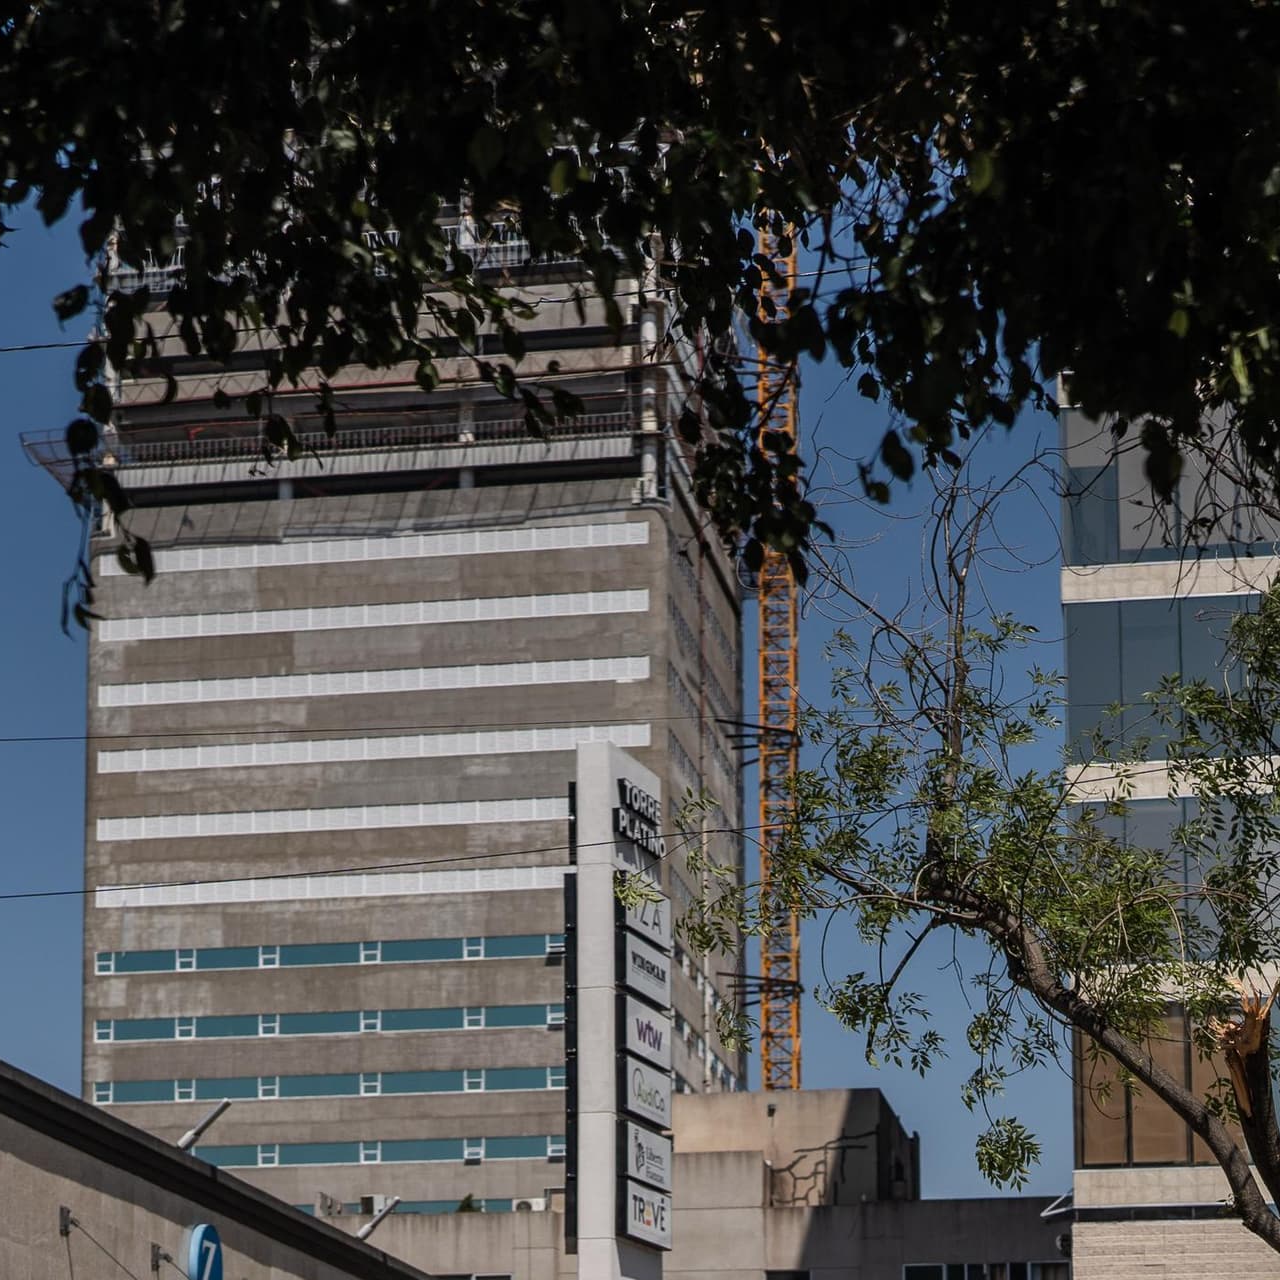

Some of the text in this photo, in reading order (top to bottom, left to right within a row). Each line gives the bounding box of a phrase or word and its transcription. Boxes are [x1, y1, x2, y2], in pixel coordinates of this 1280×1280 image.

[622, 779, 662, 826] TORRE
[619, 808, 667, 859] PLATINO
[635, 1017, 663, 1052] wtw
